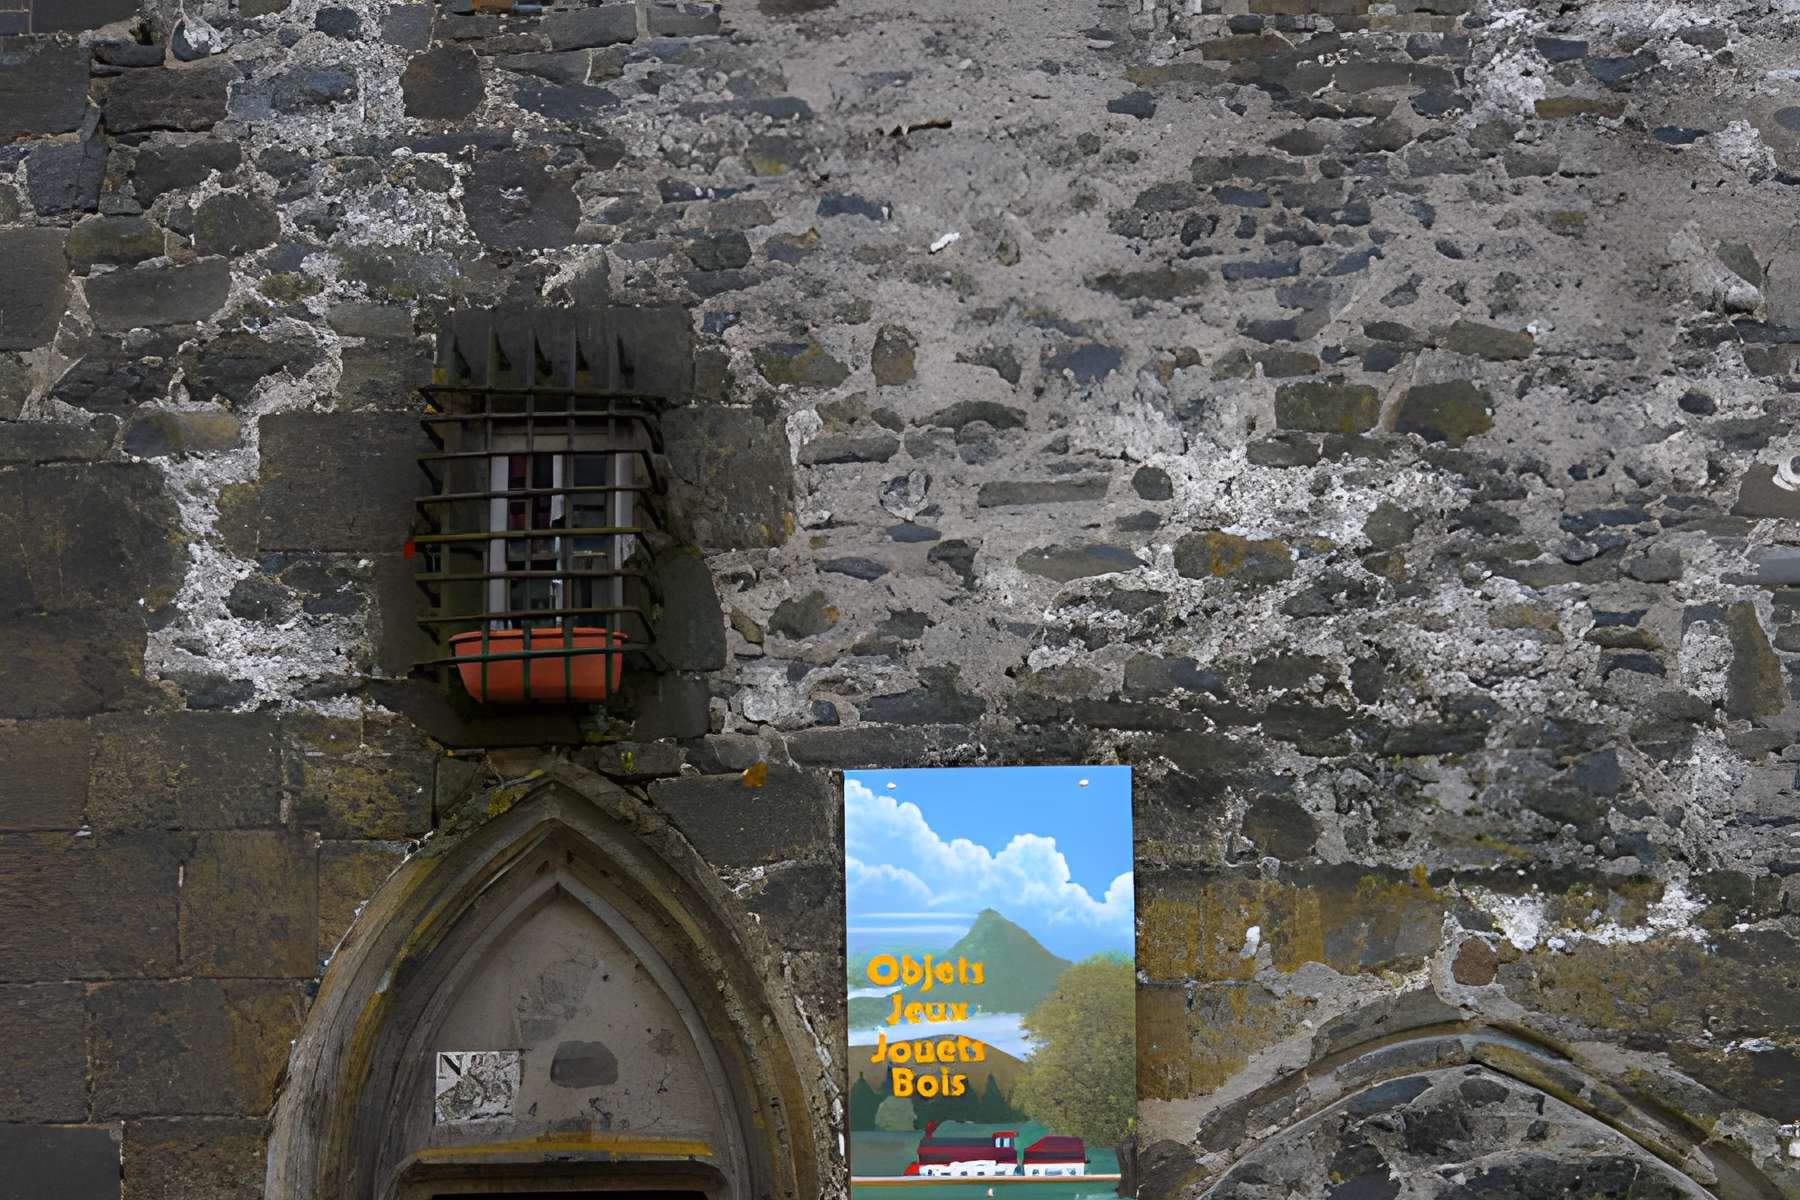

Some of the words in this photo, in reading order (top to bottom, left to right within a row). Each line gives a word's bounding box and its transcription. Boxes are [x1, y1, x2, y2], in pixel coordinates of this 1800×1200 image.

[867, 954, 985, 992] Objets
[886, 994, 969, 1026] Jeux
[870, 1032, 986, 1064] Jouets
[891, 1067, 968, 1098] Bois
